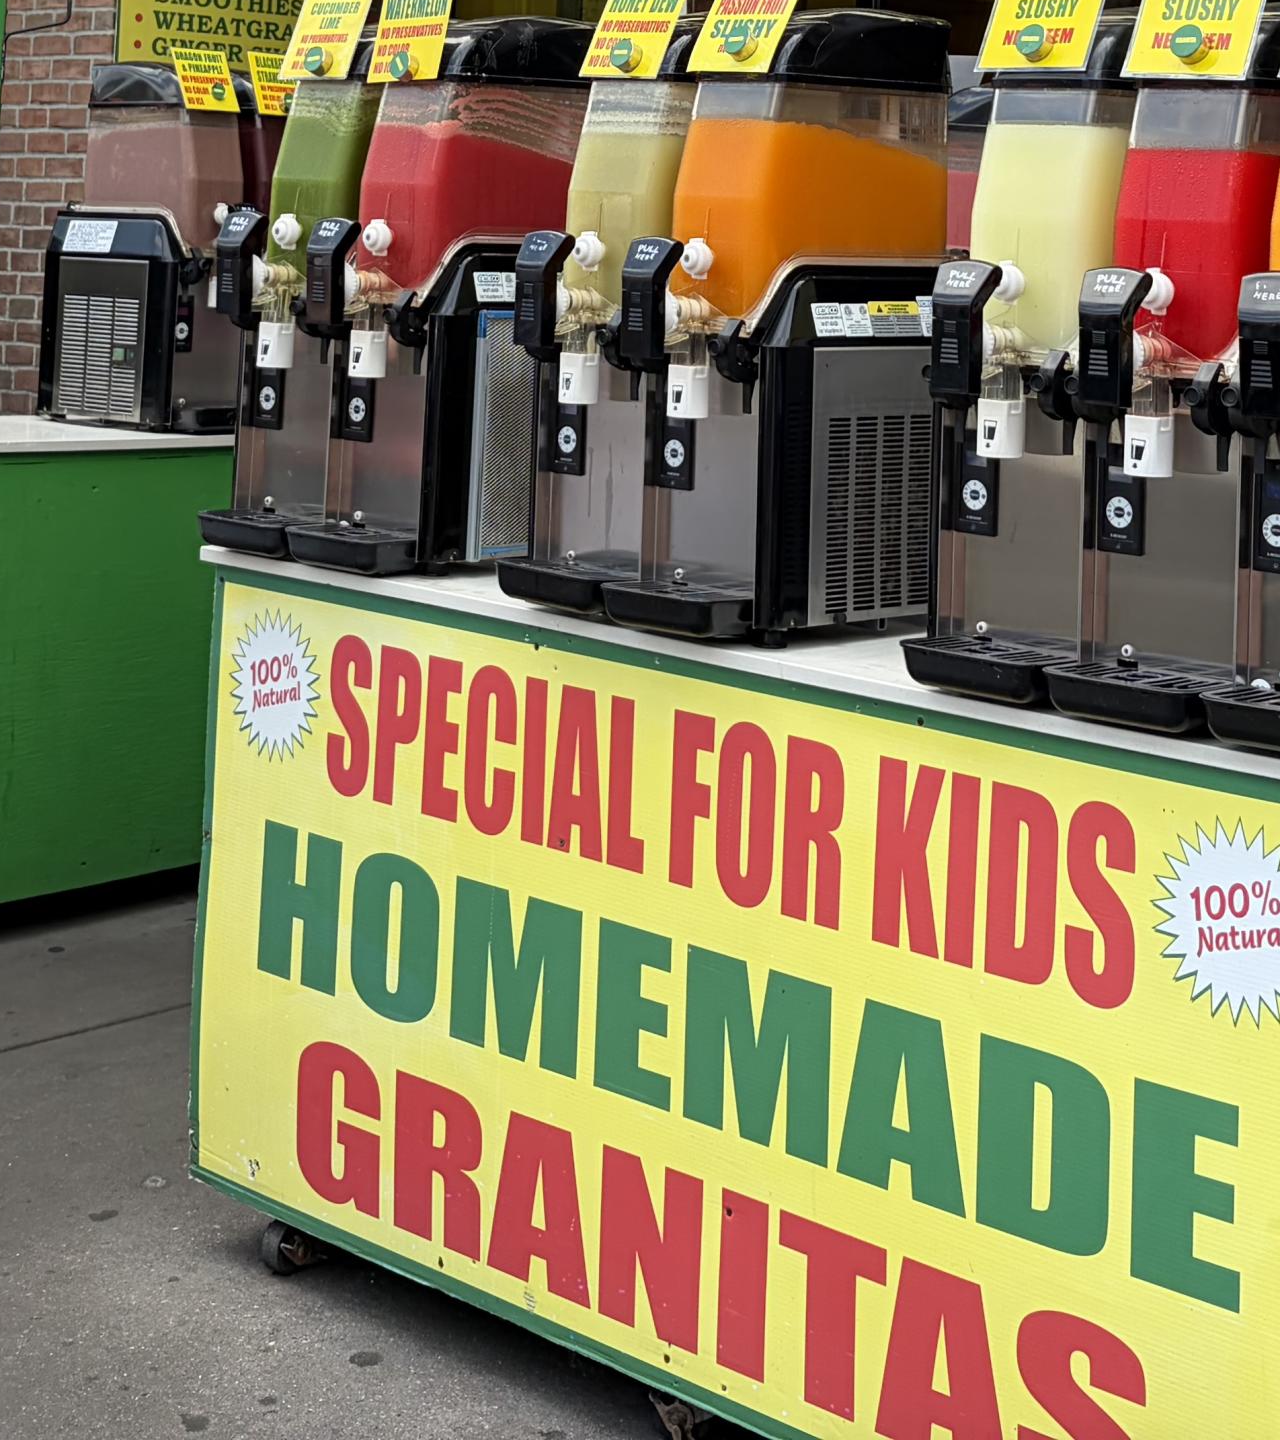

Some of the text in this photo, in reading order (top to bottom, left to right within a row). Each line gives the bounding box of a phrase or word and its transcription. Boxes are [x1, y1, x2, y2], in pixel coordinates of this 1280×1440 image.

[310, 1, 361, 16] CUCUMBER
[319, 17, 342, 30] LIME
[600, 19, 671, 33] NO PRESERVATIVES
[380, 23, 444, 40] NO PRESERVATIVES
[595, 37, 606, 50] NO
[377, 44, 388, 57] NO
[373, 62, 384, 74] NO
[587, 55, 599, 68] NO
[188, 63, 224, 75] PINEAPPLE
[637, 244, 659, 254] PULL
[949, 269, 976, 281] PULL
[1096, 274, 1126, 285] PULL
[250, 653, 298, 687] 100%
[252, 681, 301, 712] Natural
[325, 634, 1138, 1010] SPECIAL FOR KIDS
[256, 818, 1241, 1312] HOMEMADE
[295, 1040, 1147, 1440] GRANITAS
